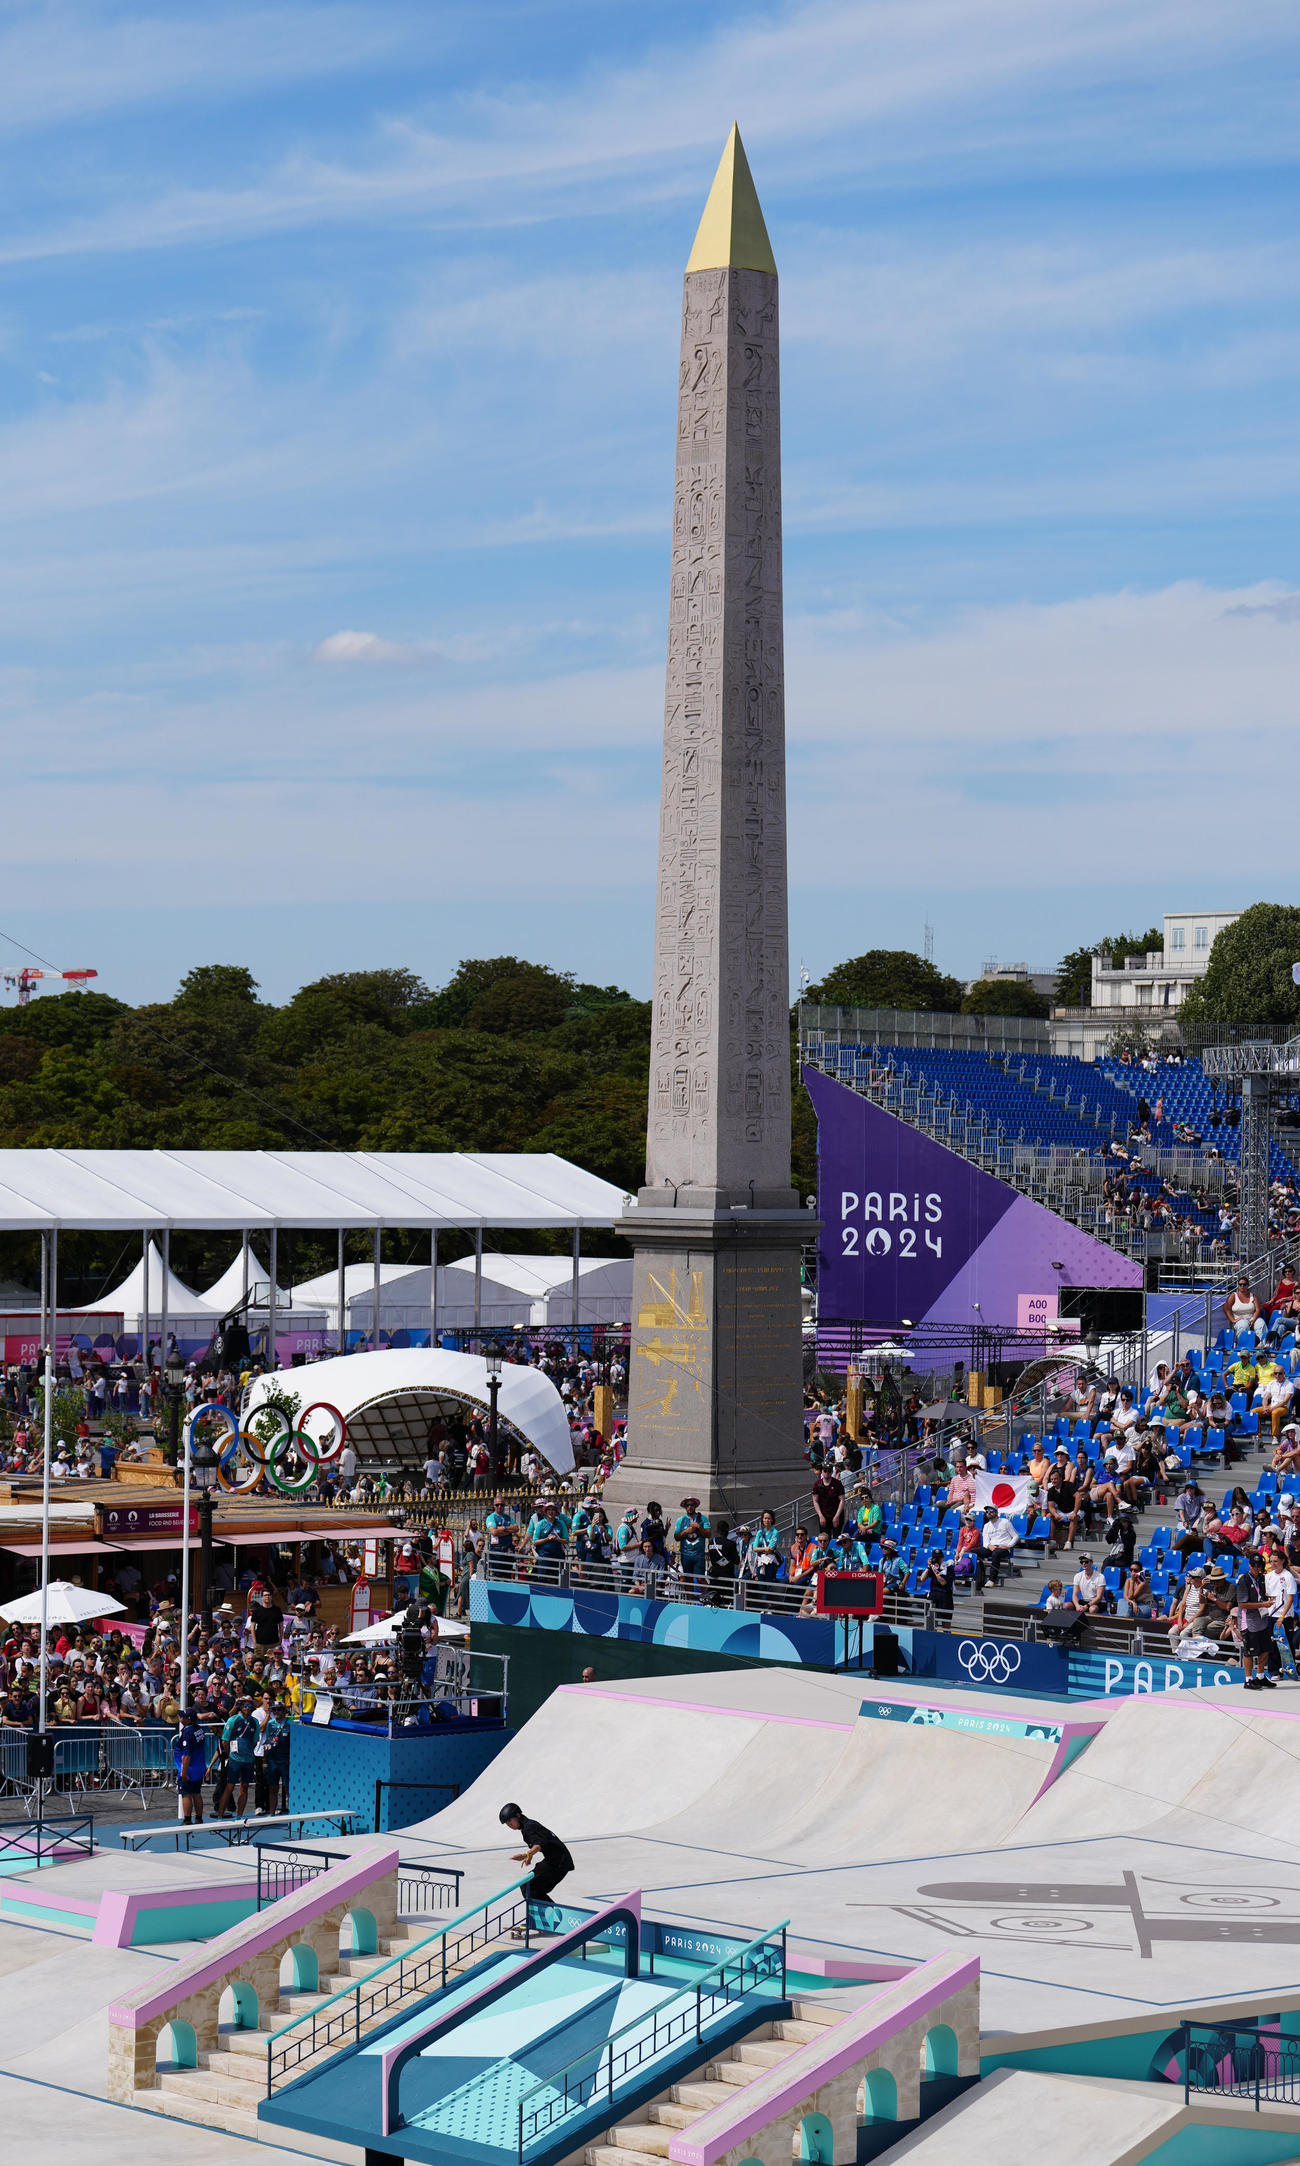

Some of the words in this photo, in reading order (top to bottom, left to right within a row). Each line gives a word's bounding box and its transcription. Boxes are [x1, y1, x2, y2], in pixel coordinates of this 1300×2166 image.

[842, 1227, 942, 1258] 2024
[986, 1720, 1010, 1733] 2024
[696, 1941, 721, 1955] 2024
